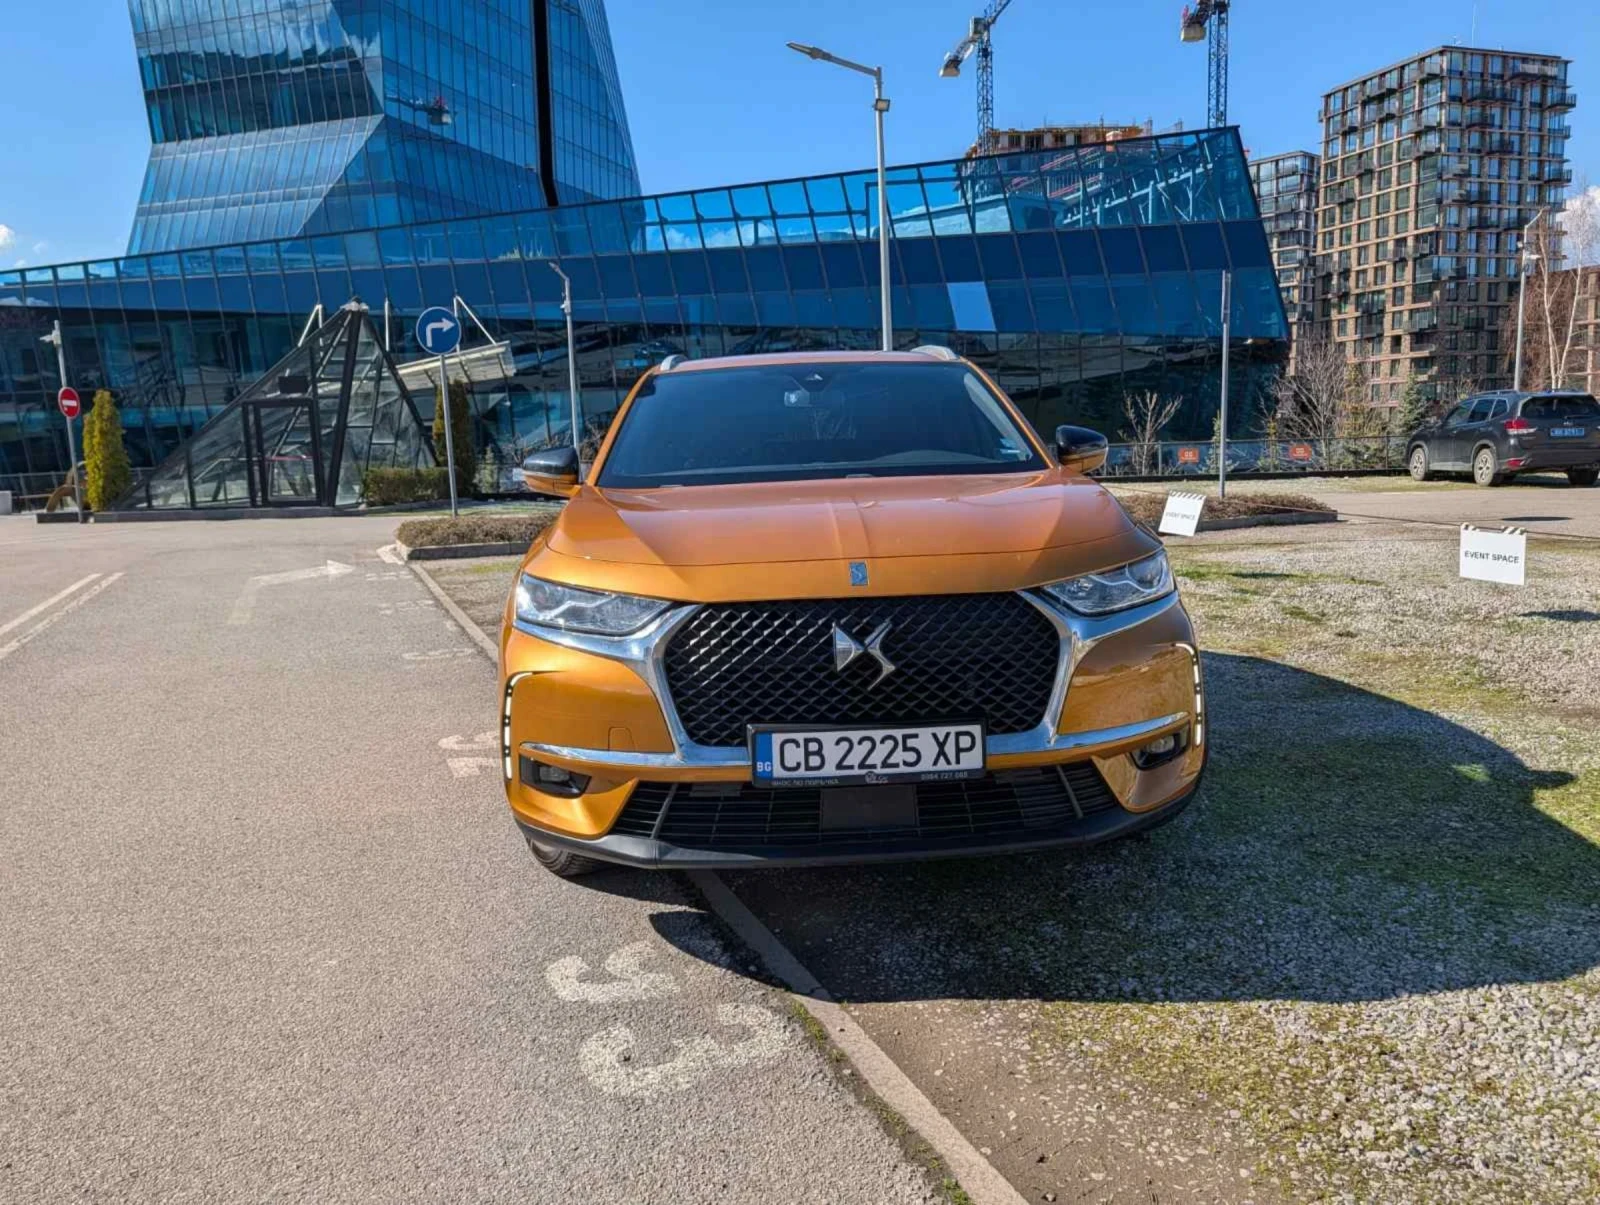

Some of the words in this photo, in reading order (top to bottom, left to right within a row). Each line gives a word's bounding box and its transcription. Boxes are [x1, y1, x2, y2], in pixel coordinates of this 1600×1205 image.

[1464, 550, 1490, 560] EVENT
[1492, 553, 1520, 564] SPACE
[778, 737, 826, 772] CB
[834, 733, 922, 770] 2225
[931, 730, 976, 767] XP
[756, 761, 772, 772] BG
